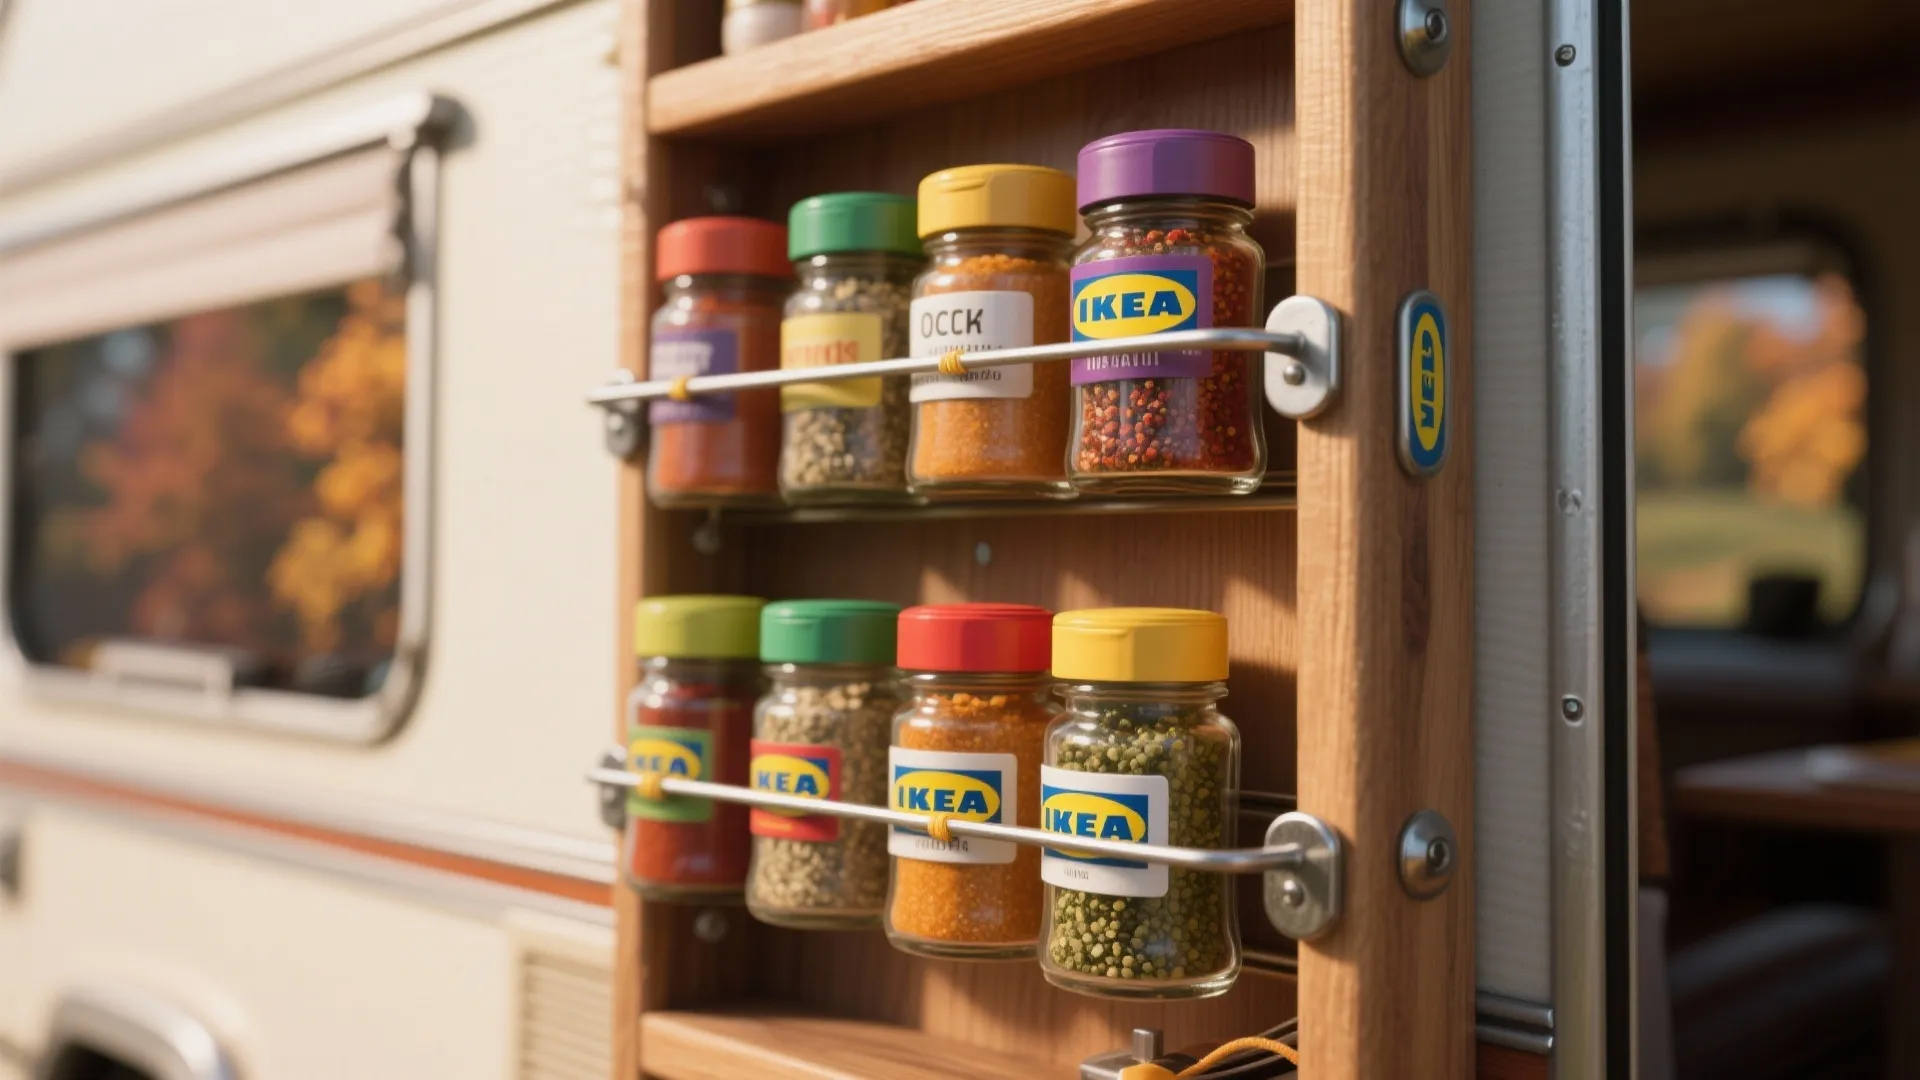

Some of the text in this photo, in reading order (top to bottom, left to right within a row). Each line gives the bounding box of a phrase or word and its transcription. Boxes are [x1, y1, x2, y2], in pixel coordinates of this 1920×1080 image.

[1079, 290, 1183, 323] IKEA
[921, 308, 983, 339] OCCK
[898, 785, 989, 814] IKEA
[1045, 806, 1134, 841] IKEA
